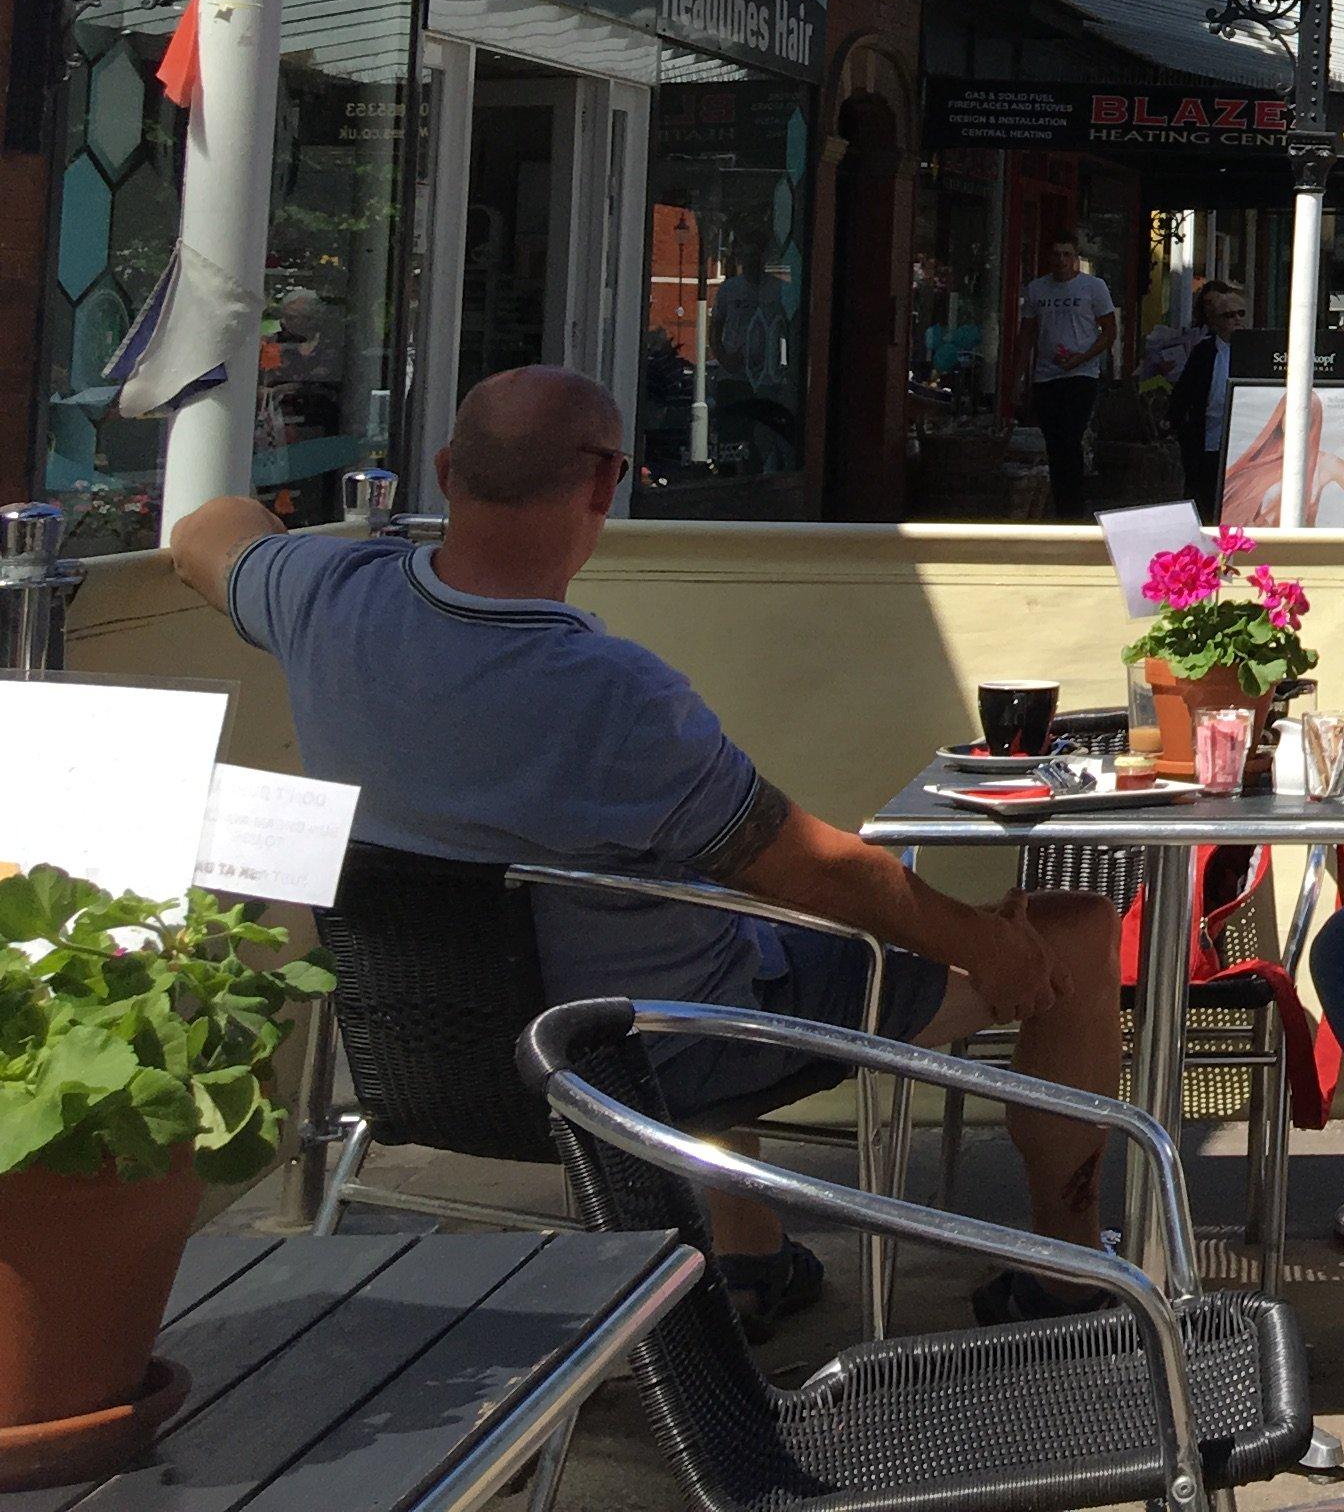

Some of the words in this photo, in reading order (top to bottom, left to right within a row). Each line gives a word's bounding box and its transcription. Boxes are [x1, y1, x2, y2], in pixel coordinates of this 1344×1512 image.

[998, 92, 1027, 101] SOLID
[1030, 93, 1054, 102] FUEL
[948, 100, 1009, 110] FIREPLACES
[1011, 102, 1032, 111] AND
[1034, 103, 1073, 113] STOVES
[1091, 95, 1296, 131] BLAZE
[949, 115, 986, 123] DESIGN
[998, 116, 1067, 126] INSTALLATION
[961, 128, 1007, 137] CENTRAL
[1010, 130, 1052, 139] HEATING
[1089, 129, 1210, 145] HEATING
[1038, 298, 1081, 307] NICCE
